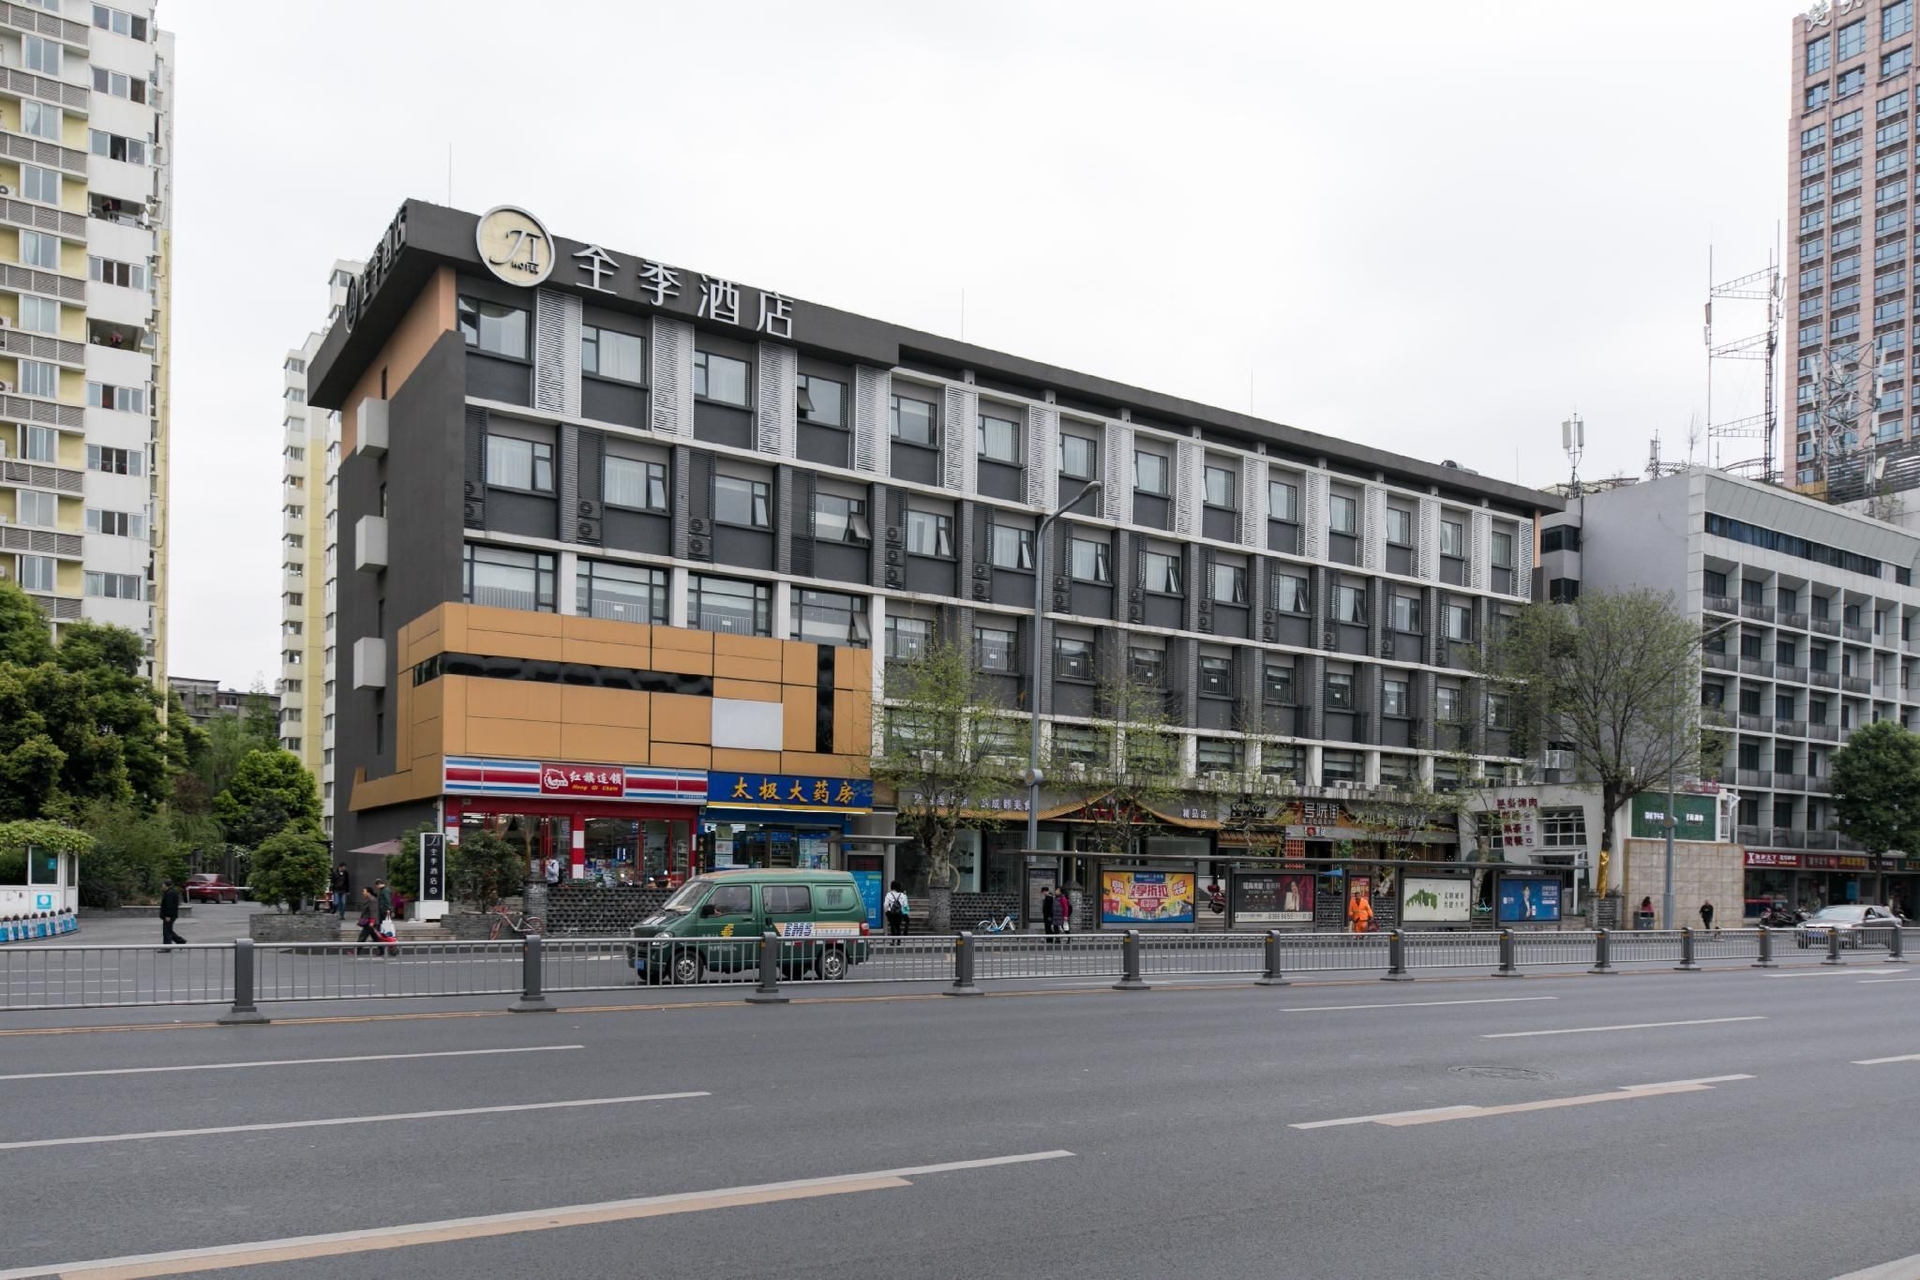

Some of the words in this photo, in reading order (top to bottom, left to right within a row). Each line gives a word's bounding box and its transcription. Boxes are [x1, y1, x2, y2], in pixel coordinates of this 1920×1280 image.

[572, 243, 795, 340] 全季酒店
[569, 770, 622, 785] 红旗连锁
[732, 776, 855, 805] 太极大药房
[1182, 808, 1207, 819] 精品店
[430, 848, 438, 885] 全季酒店
[784, 922, 815, 937] EMS
